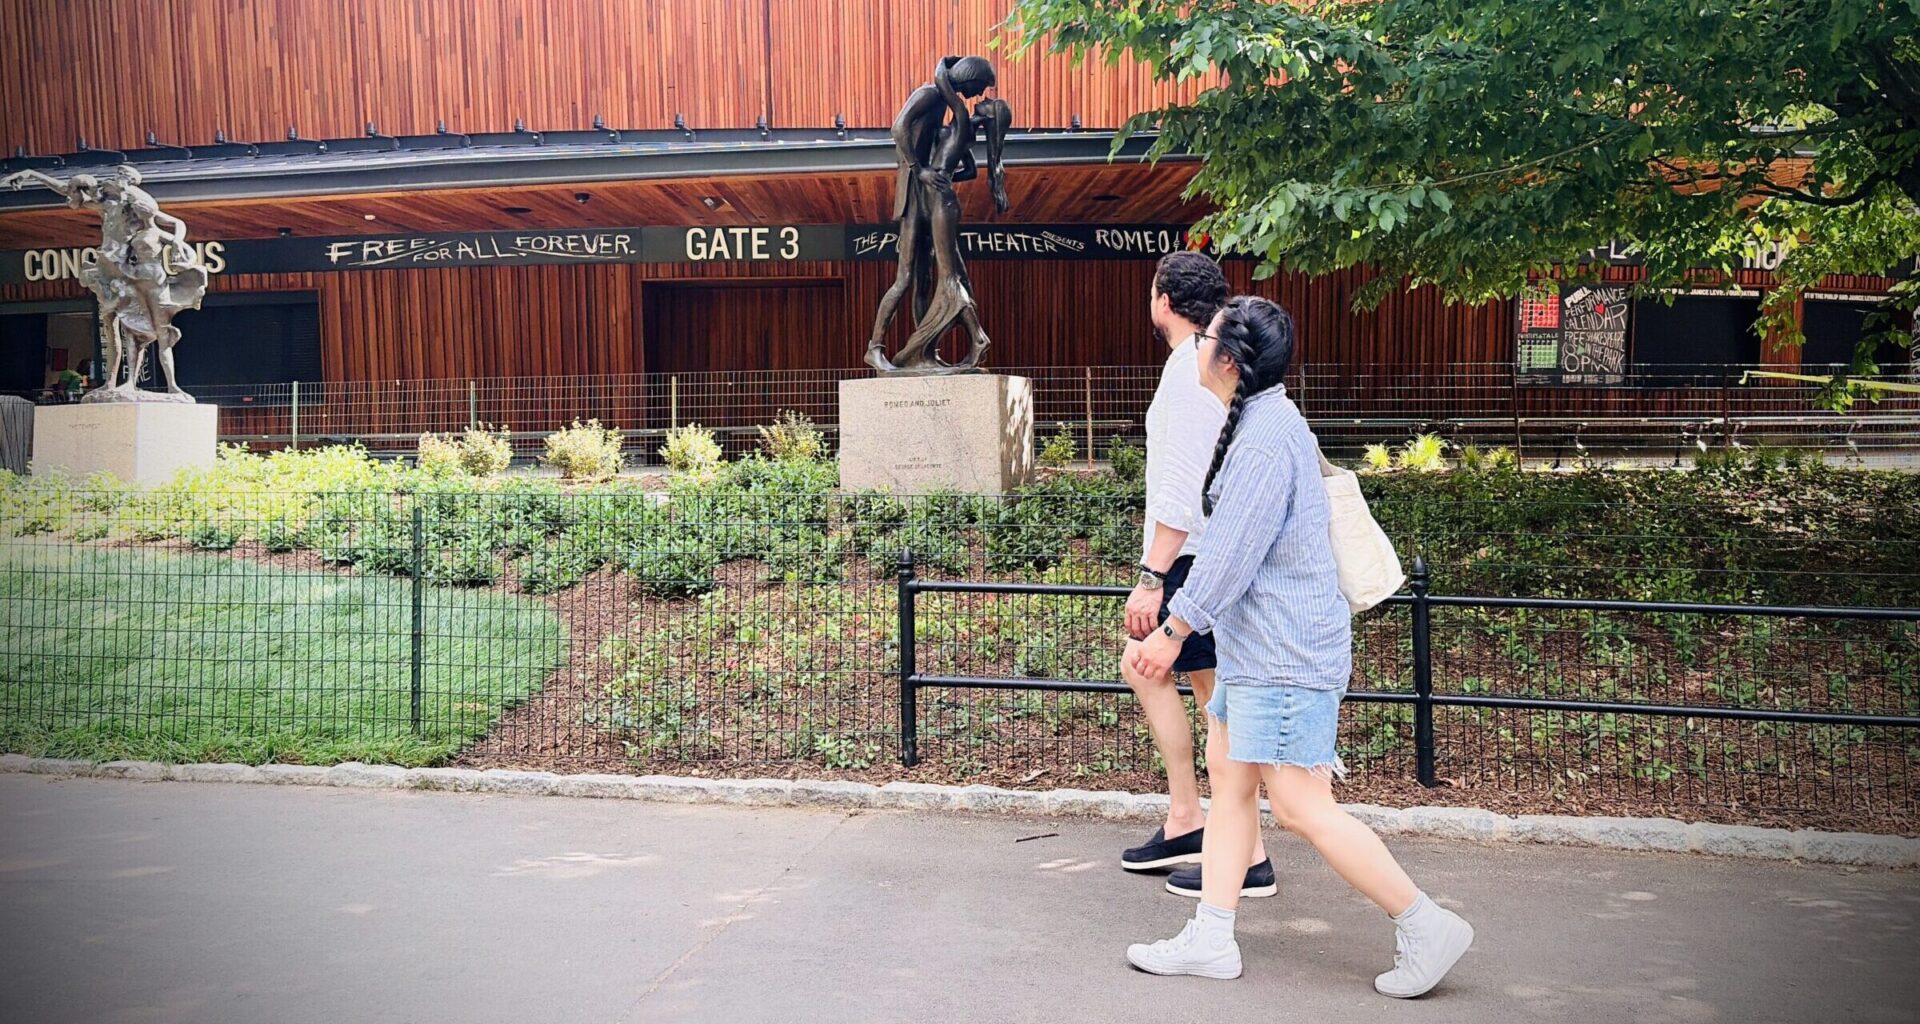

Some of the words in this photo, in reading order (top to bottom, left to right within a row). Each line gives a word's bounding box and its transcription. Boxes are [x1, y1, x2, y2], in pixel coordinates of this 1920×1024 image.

[324, 238, 436, 265] FREE.
[413, 248, 453, 262] FOR
[514, 234, 637, 254] FOREVER.
[686, 227, 770, 260] GATE
[779, 227, 799, 260] 3
[852, 232, 879, 252] THE
[960, 232, 1058, 252] THEATER
[1041, 230, 1085, 250] PRESENTS
[1095, 229, 1170, 253] ROMEO
[1564, 303, 1627, 330] CALENDAR
[1565, 288, 1626, 317] PERFORMANCE
[1565, 331, 1586, 347] FREE
[1586, 331, 1625, 352] SHAKESPEARE
[1585, 342, 1591, 356] IN
[1591, 343, 1603, 361] THE
[1602, 347, 1624, 374] PARK
[910, 400, 924, 408] AND
[927, 399, 951, 407] JULIET
